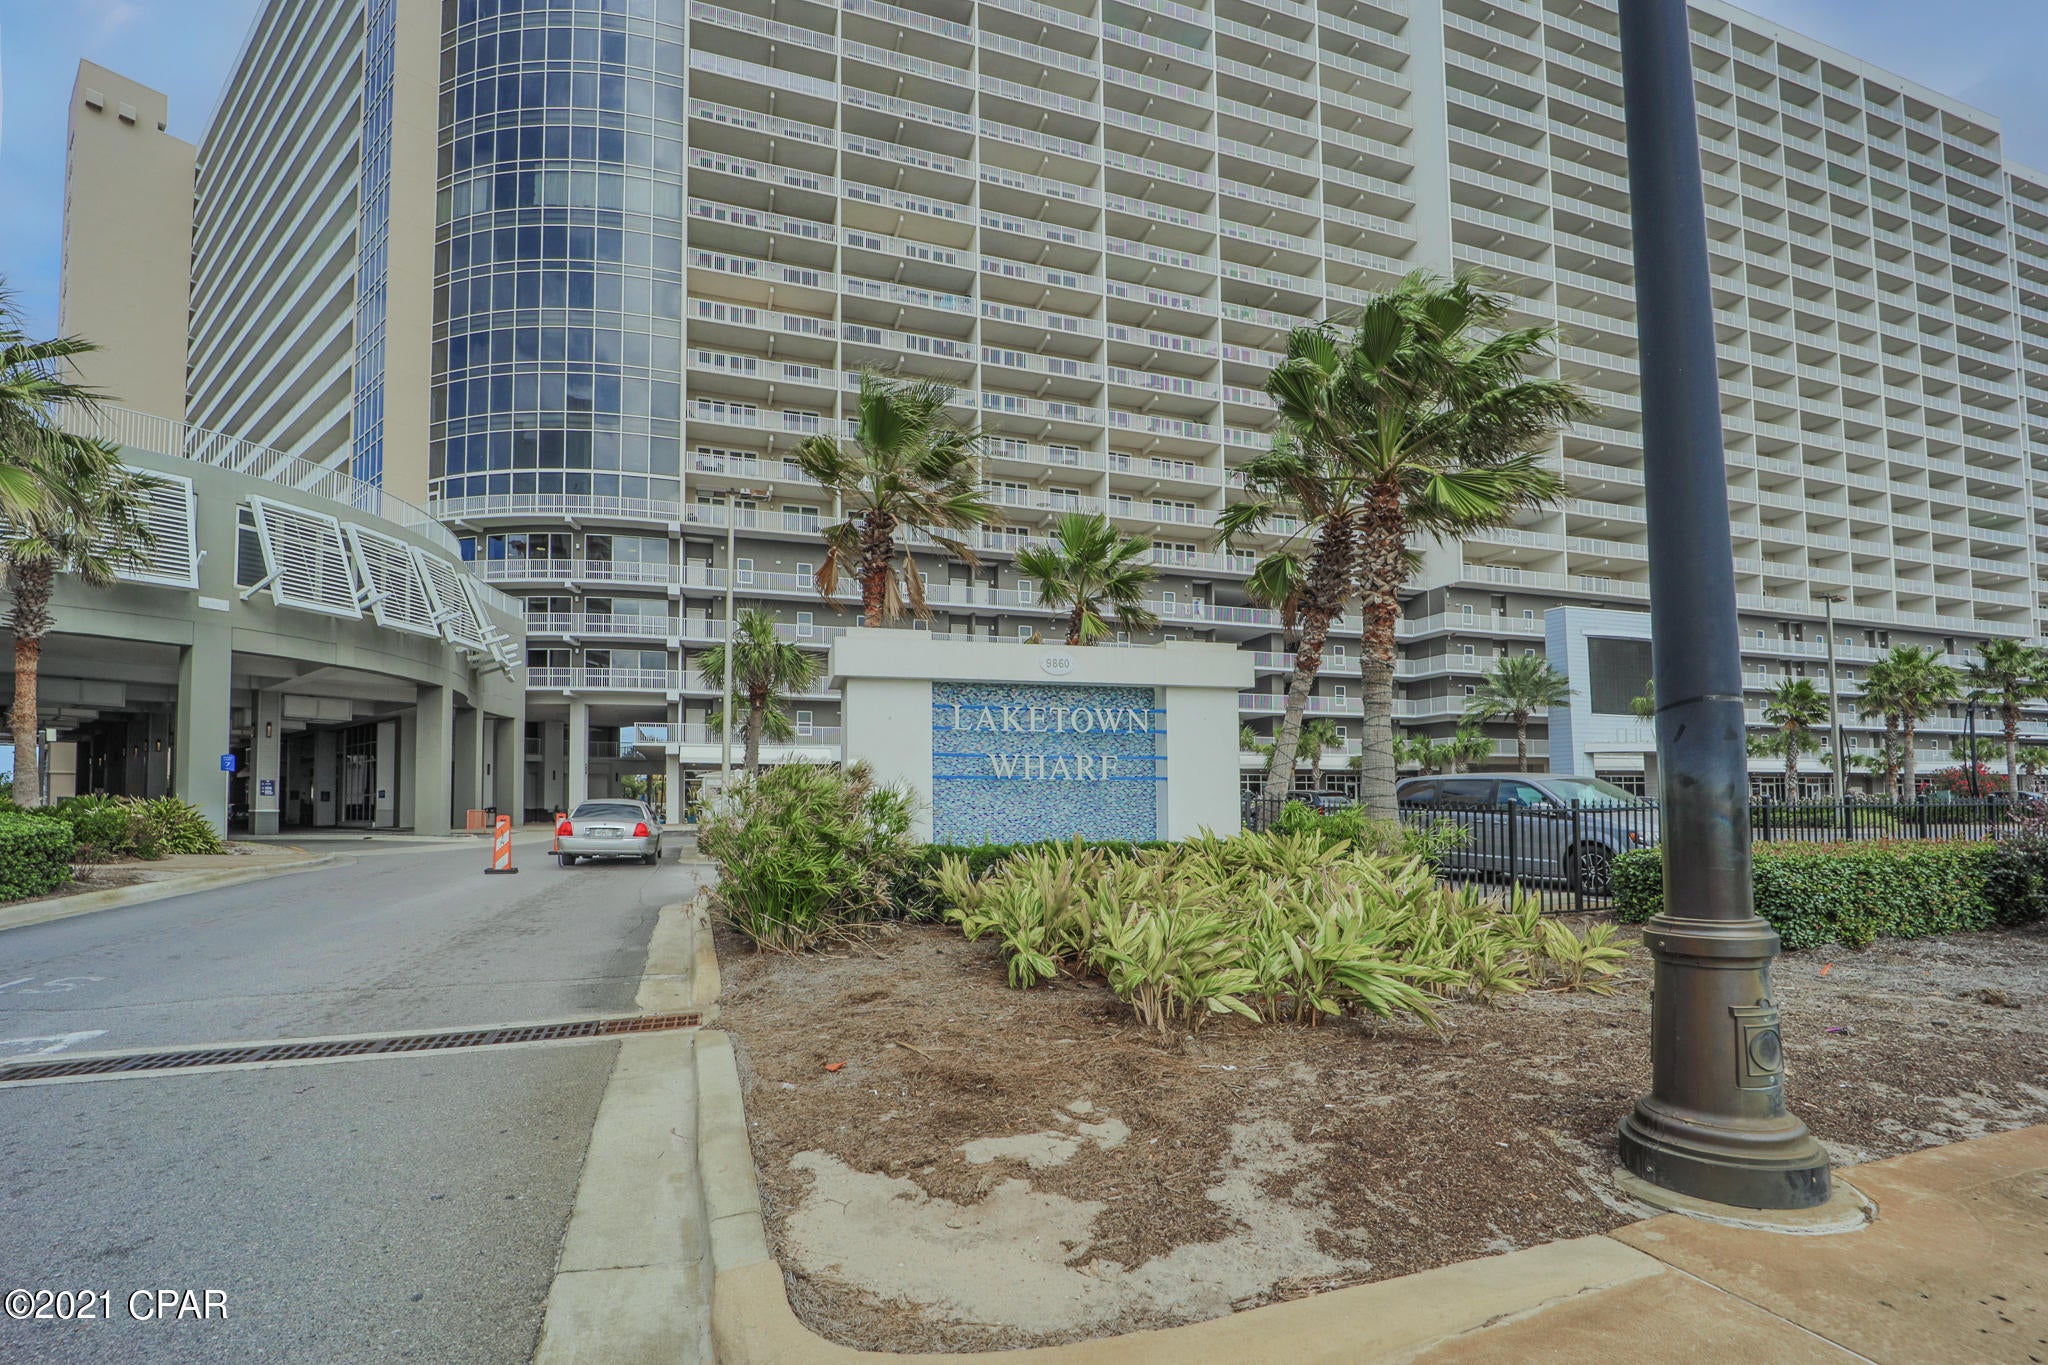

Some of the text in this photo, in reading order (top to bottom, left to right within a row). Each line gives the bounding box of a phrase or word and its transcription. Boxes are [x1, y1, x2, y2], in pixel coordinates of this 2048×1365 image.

[1046, 658, 1070, 669] 9860
[952, 705, 1150, 733] LAKETOWN
[988, 754, 1119, 780] WHARF
